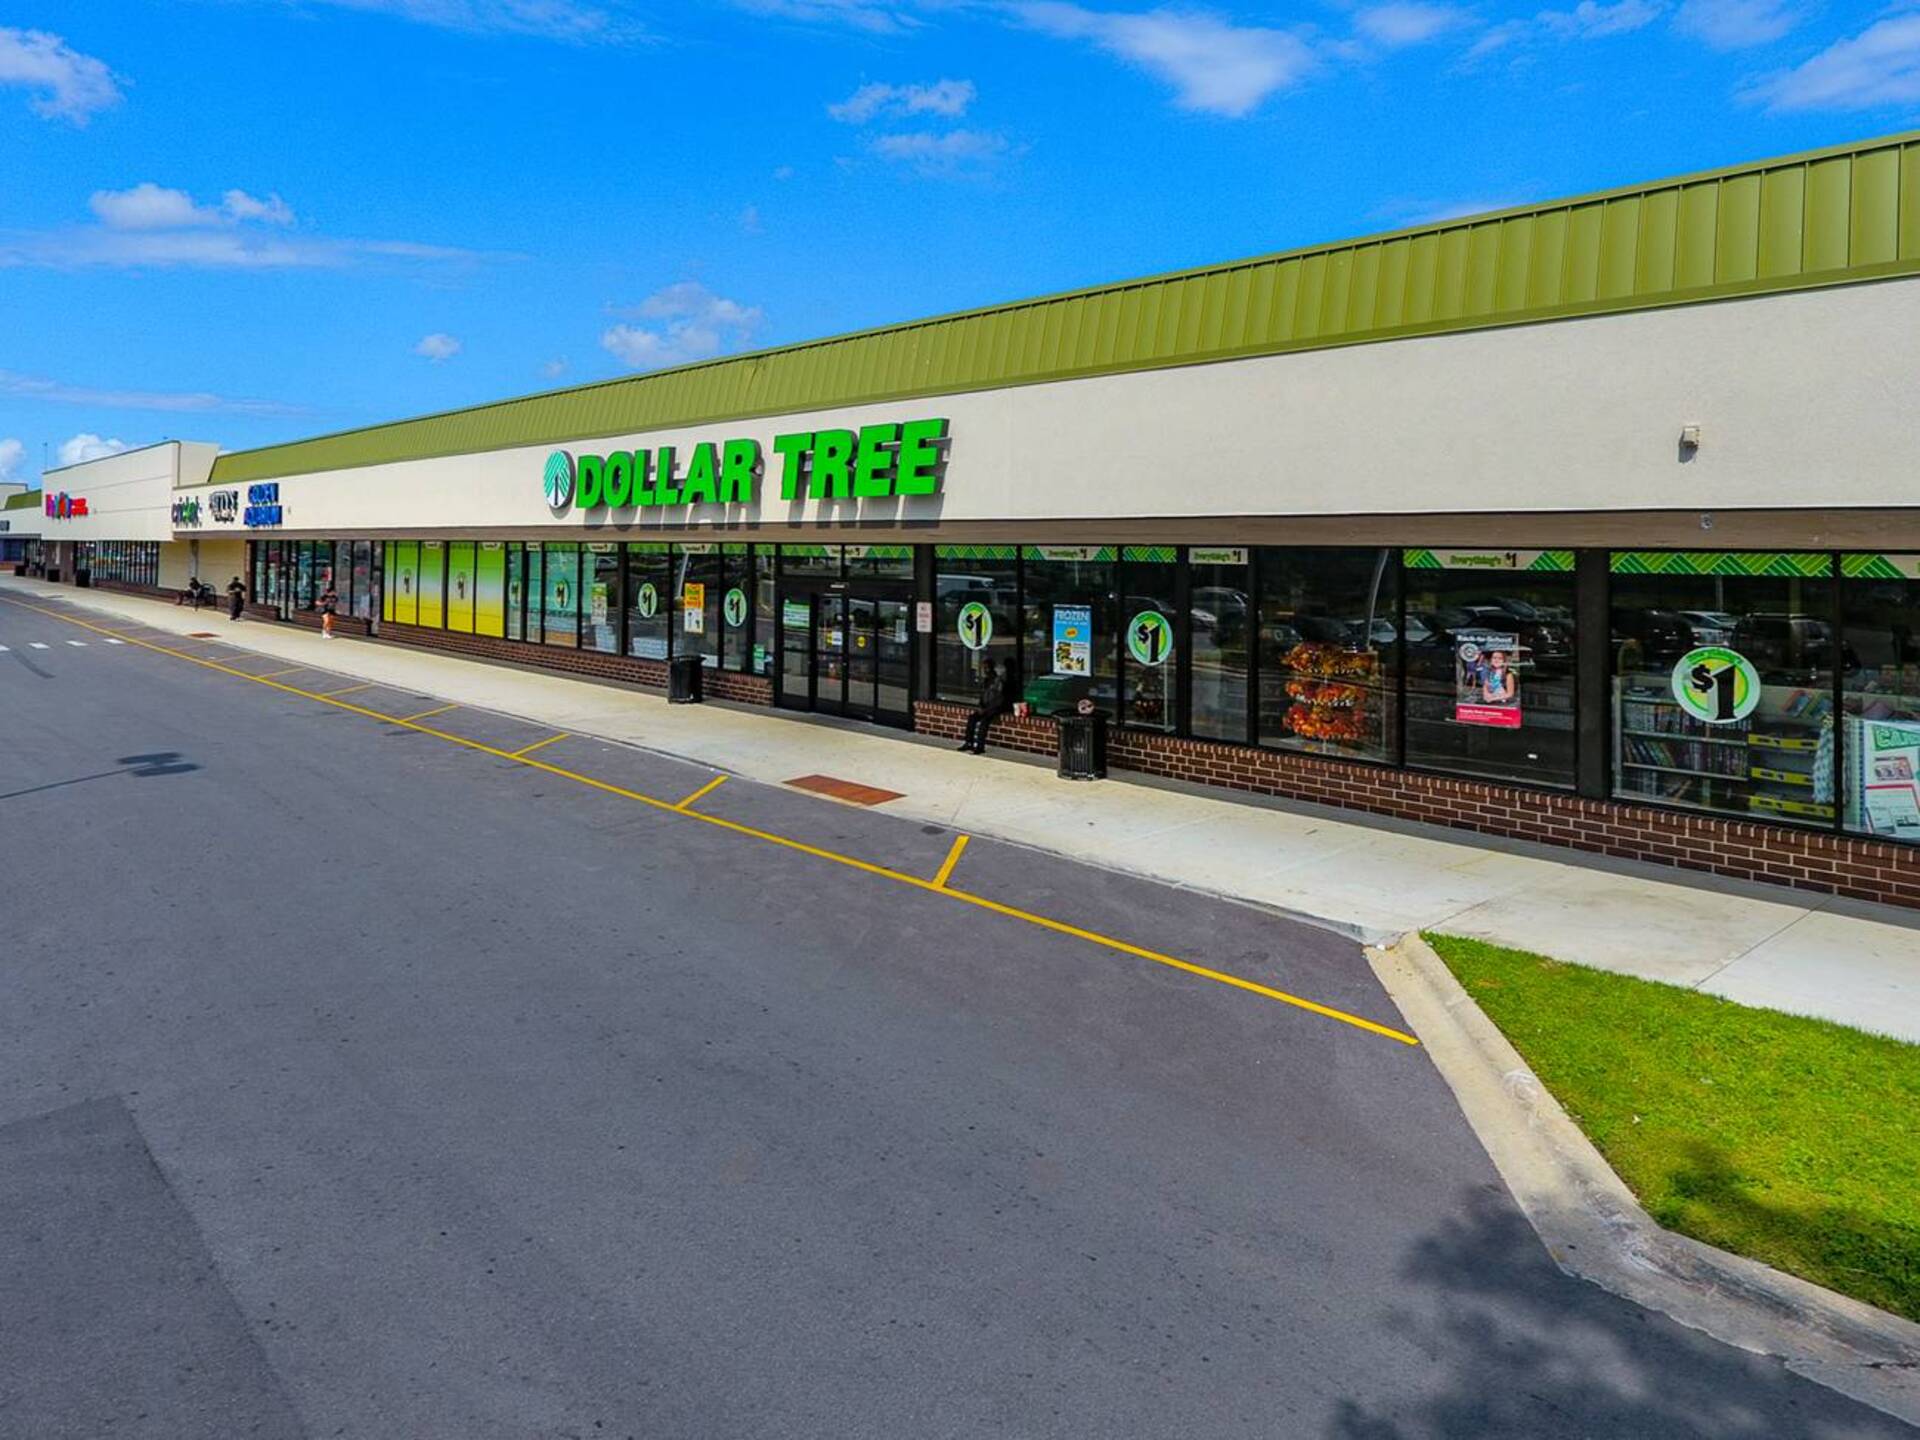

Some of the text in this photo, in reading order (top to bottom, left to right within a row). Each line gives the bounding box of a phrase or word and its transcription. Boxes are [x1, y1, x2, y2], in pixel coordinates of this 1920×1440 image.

[576, 418, 946, 509] DOLLAR TREE
[1450, 552, 1518, 568] Everything's $1
[730, 598, 741, 624] $1
[966, 612, 984, 647] $1
[1138, 623, 1162, 662] $1
[1691, 664, 1739, 720] $1
